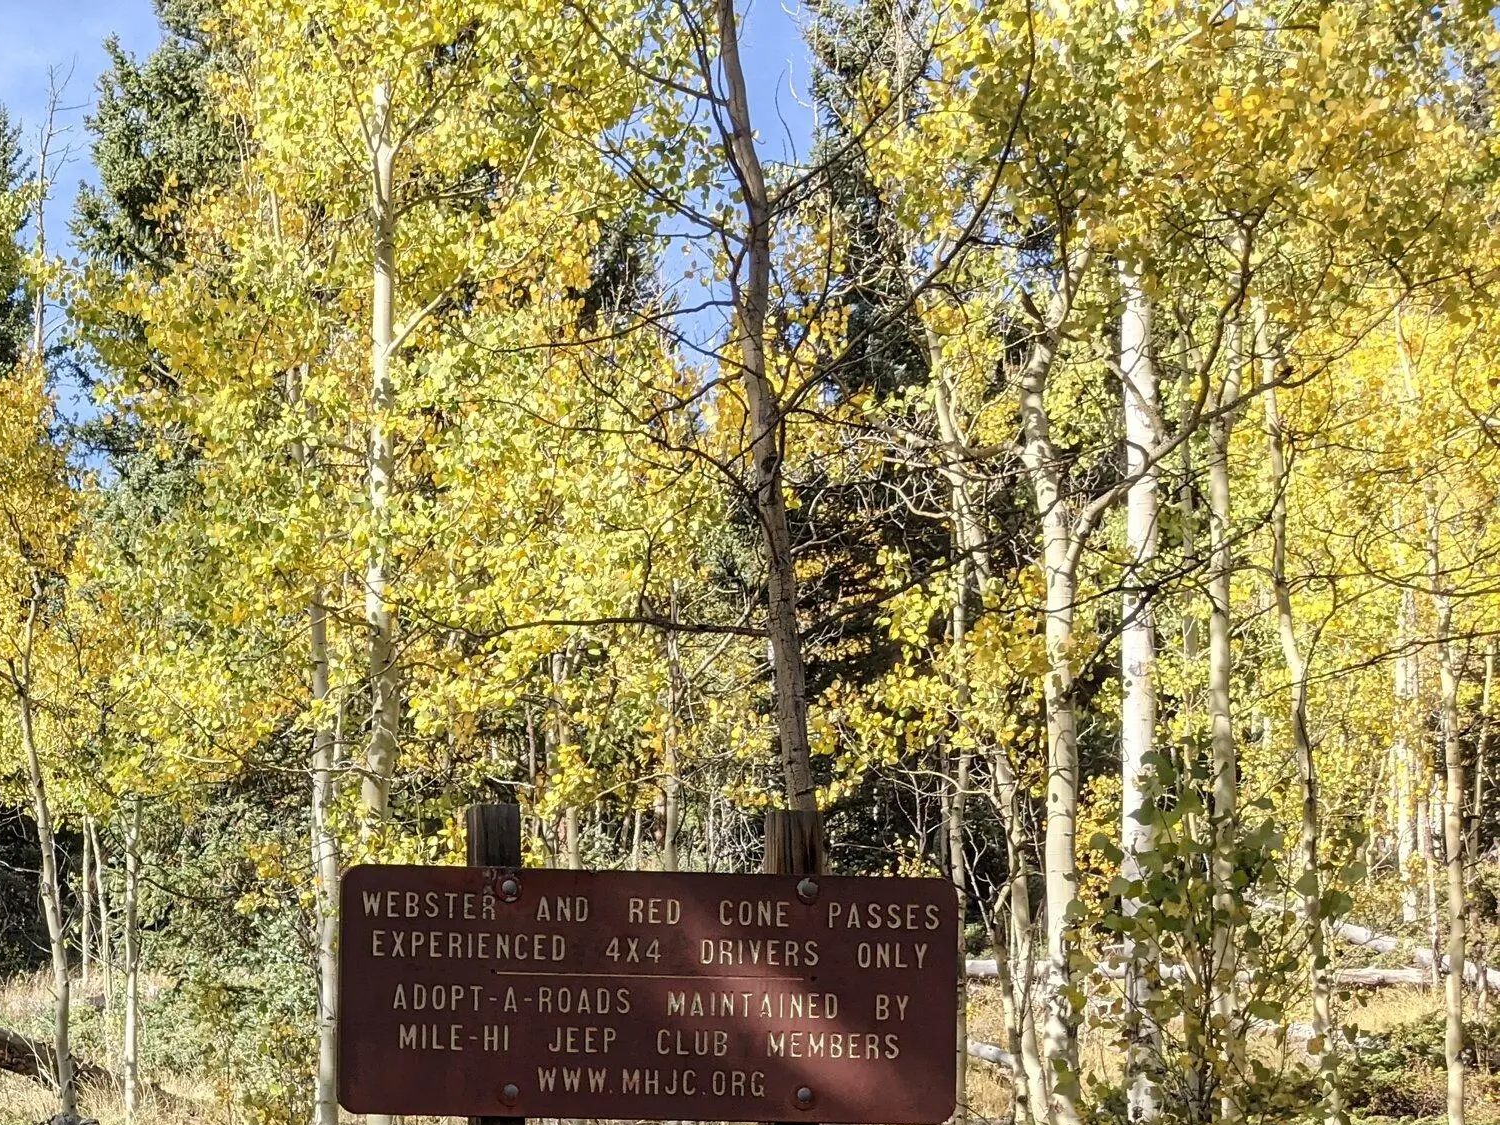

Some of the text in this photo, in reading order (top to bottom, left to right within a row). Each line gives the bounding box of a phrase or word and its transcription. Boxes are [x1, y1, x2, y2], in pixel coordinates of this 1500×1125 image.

[362, 890, 940, 930] WEBSTER AND RED CONE PASSES
[372, 930, 928, 969] EXPERIENCED 4X4 DRIVERS ONLY
[393, 983, 910, 1021] ADOPT-A-ROADS MAINTAINED BY
[399, 1023, 900, 1060] MILE-HI JEEP CLUB MEMBERS
[537, 1066, 766, 1097] WWW.MHJC.ORG
